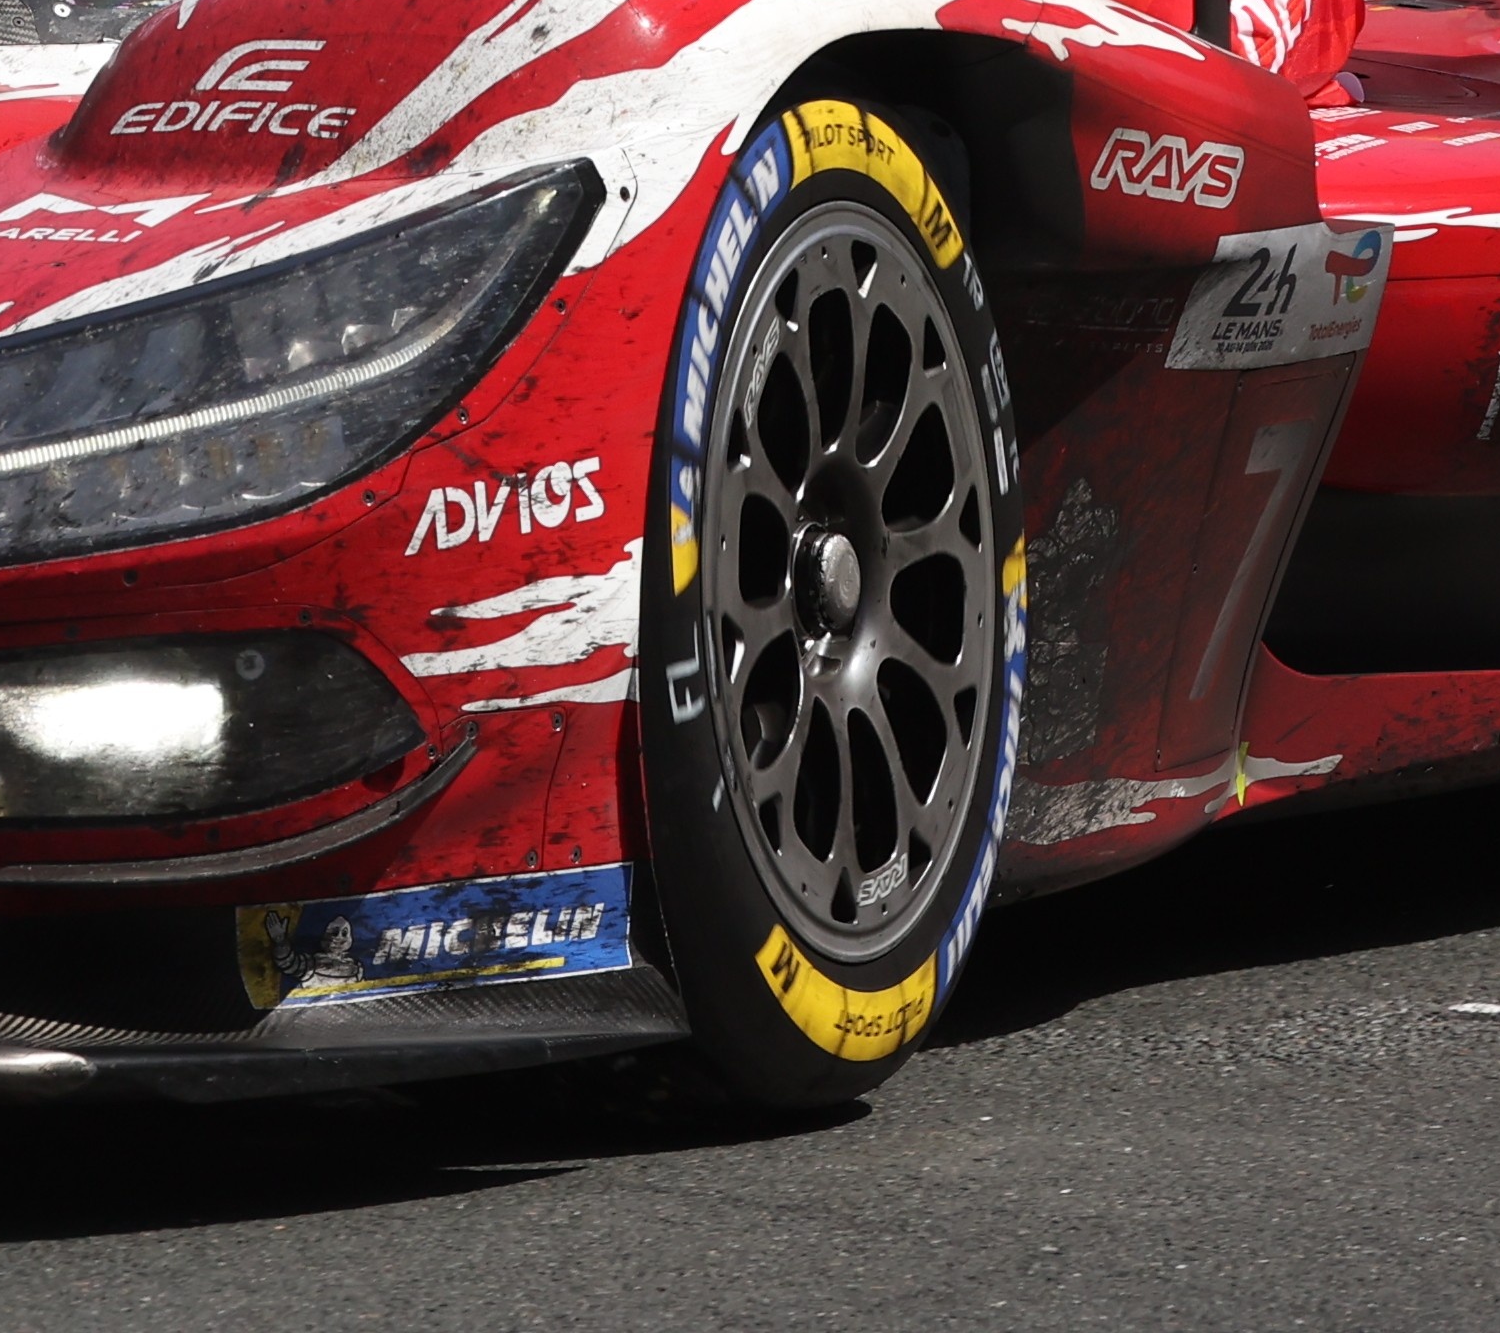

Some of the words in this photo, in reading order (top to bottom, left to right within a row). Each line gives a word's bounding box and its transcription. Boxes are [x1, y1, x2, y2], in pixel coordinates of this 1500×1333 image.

[110, 101, 358, 140] EDIFICE
[804, 122, 844, 153] PILOT
[846, 122, 896, 166] SPORT
[1090, 127, 1246, 209] RAYS
[684, 146, 781, 446] MICHELIN
[1211, 321, 1236, 341] LE
[1235, 318, 1284, 340] MANS
[1186, 419, 1316, 701] 7
[371, 902, 607, 968] MICHELIN
[834, 1008, 884, 1037] SPORT
